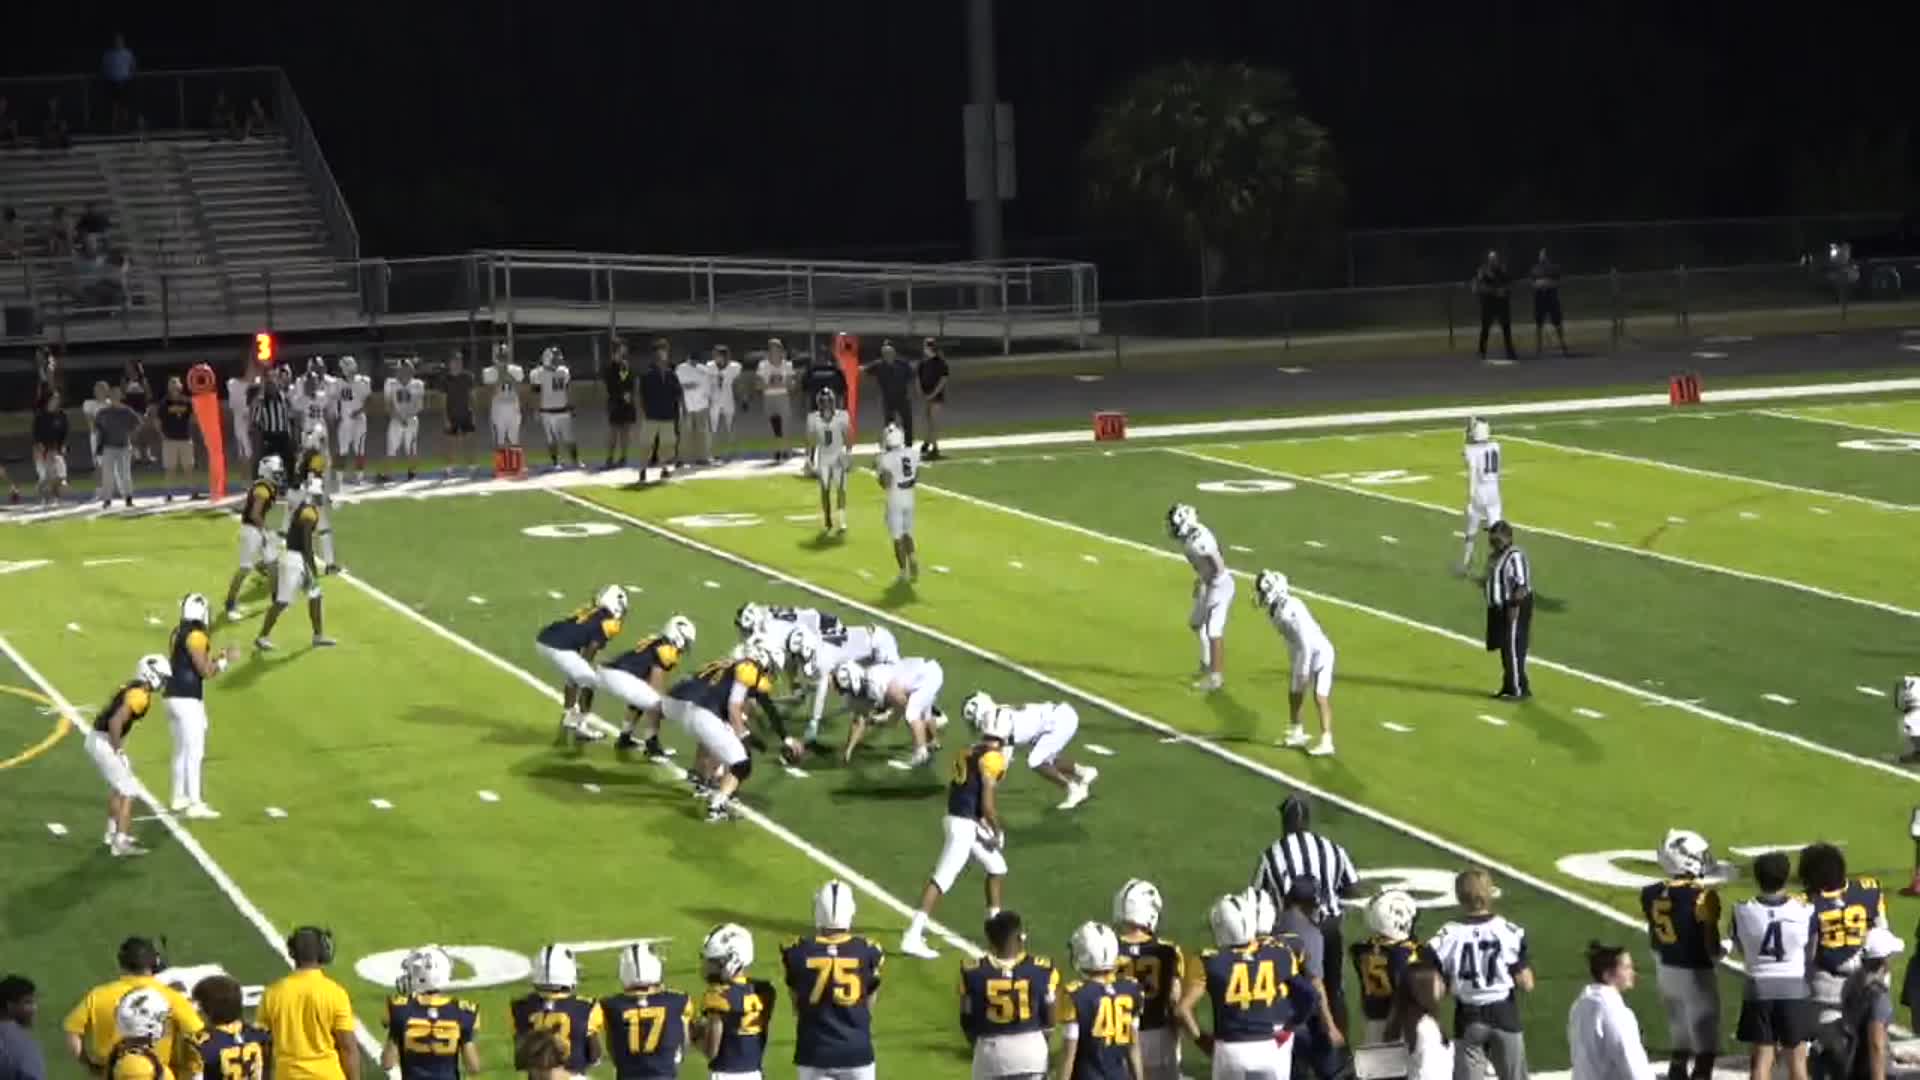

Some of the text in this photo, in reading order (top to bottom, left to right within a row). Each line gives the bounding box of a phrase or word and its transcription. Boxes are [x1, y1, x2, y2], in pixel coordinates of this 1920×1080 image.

[257, 334, 272, 361] 3
[901, 456, 912, 478] 6
[1484, 449, 1499, 475] 10
[1651, 899, 1677, 945] 5
[1758, 921, 1785, 962] 4
[806, 957, 862, 1007] 75
[1225, 959, 1277, 1011] 44
[1458, 940, 1501, 989] 47
[738, 993, 763, 1036] 2
[984, 979, 1033, 1025] 51
[1091, 993, 1135, 1046] 46
[622, 1006, 666, 1056] 17
